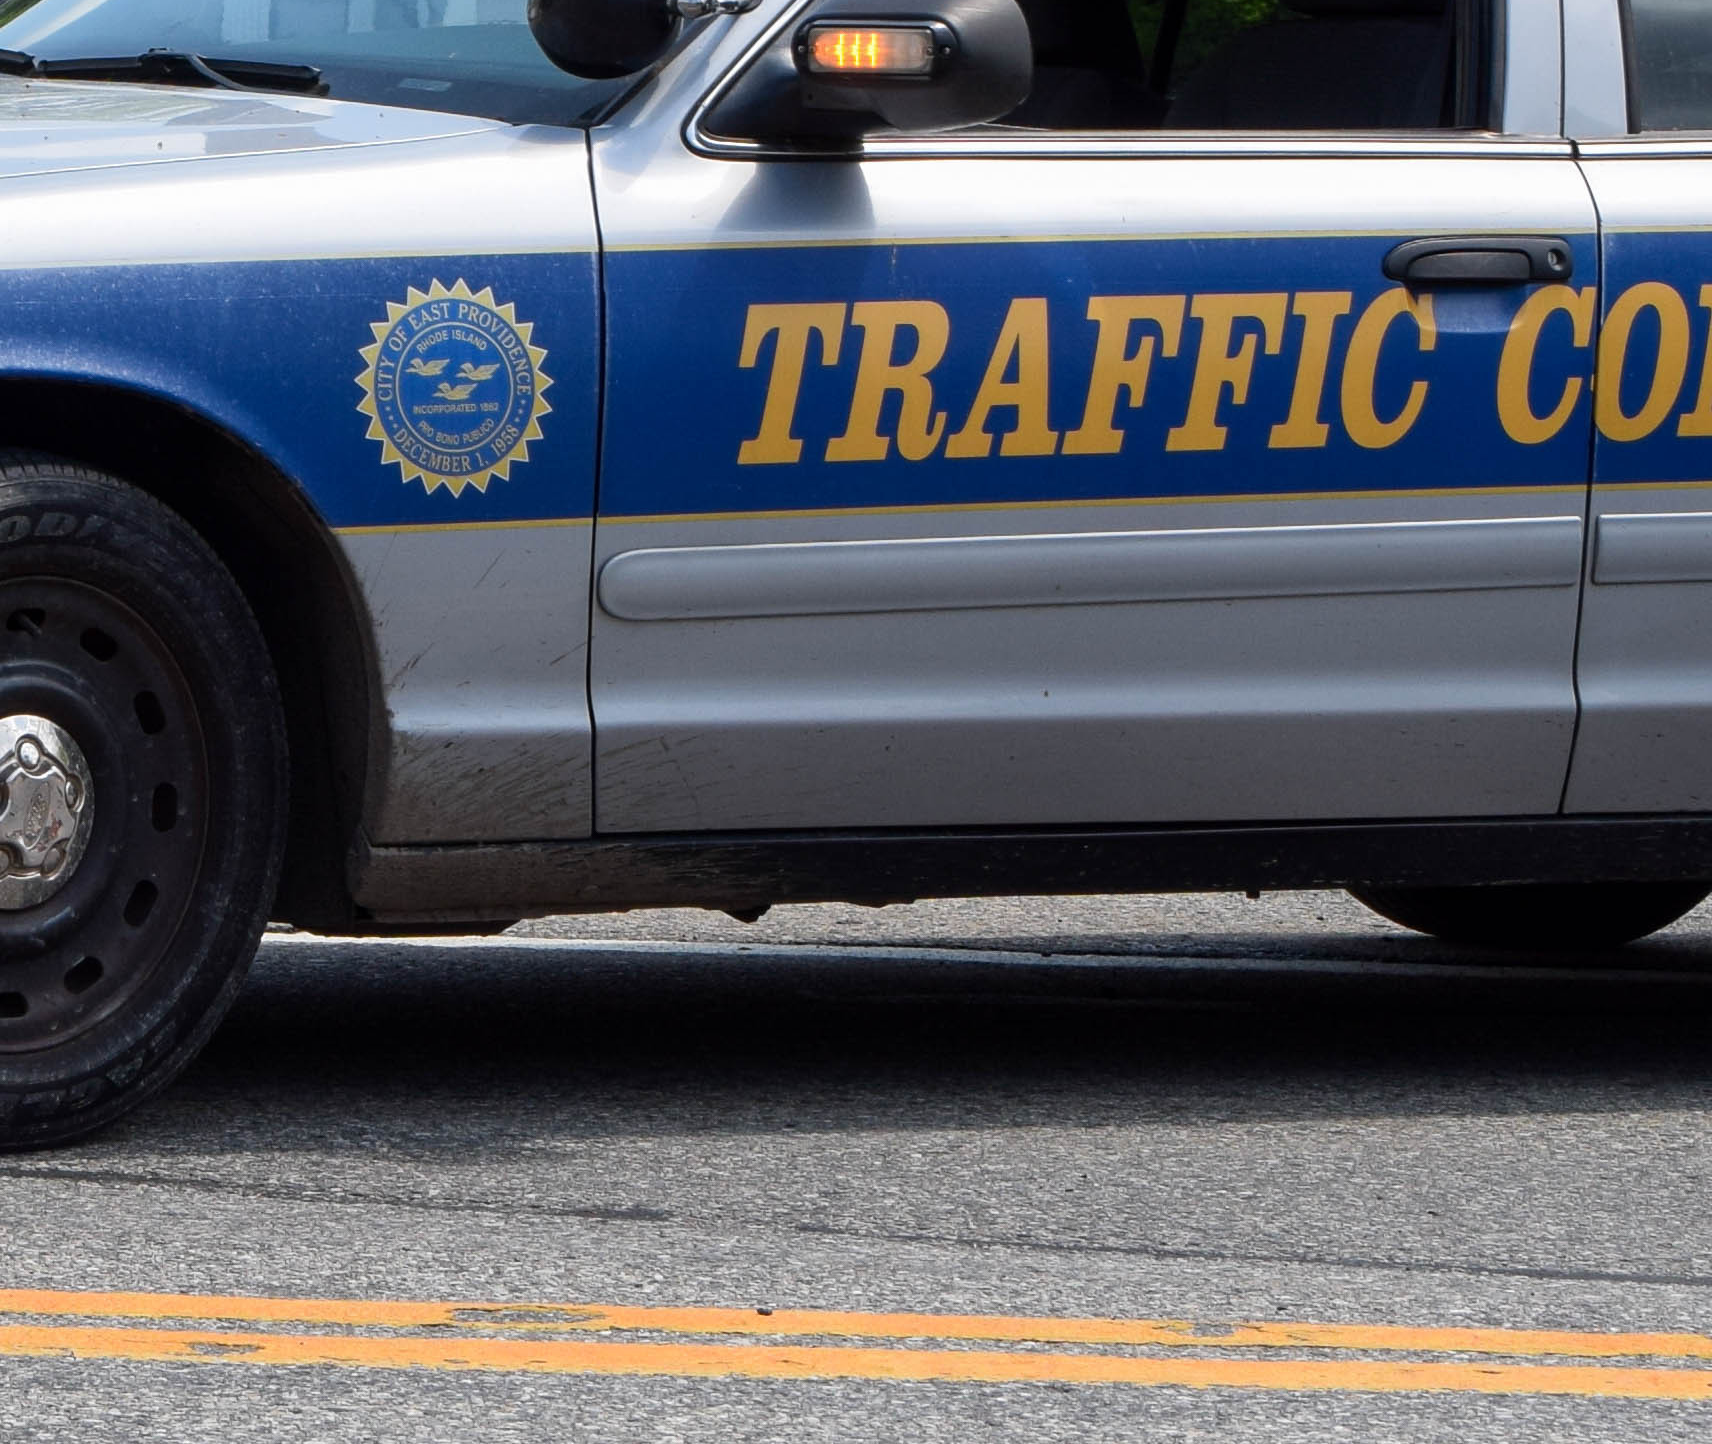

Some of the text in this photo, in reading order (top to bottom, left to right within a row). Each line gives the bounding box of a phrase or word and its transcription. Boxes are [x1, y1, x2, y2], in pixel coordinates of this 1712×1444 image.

[377, 302, 532, 401] CITY OF EAST PROVIDENCE
[416, 329, 488, 354] RHODE ISLAND
[737, 288, 1436, 465] TRAFFIC
[413, 403, 477, 414] INCORPORATED
[393, 428, 472, 473] DECEMBER
[490, 424, 519, 456] 1958
[418, 419, 434, 438] PRO
[435, 432, 461, 445] BONO
